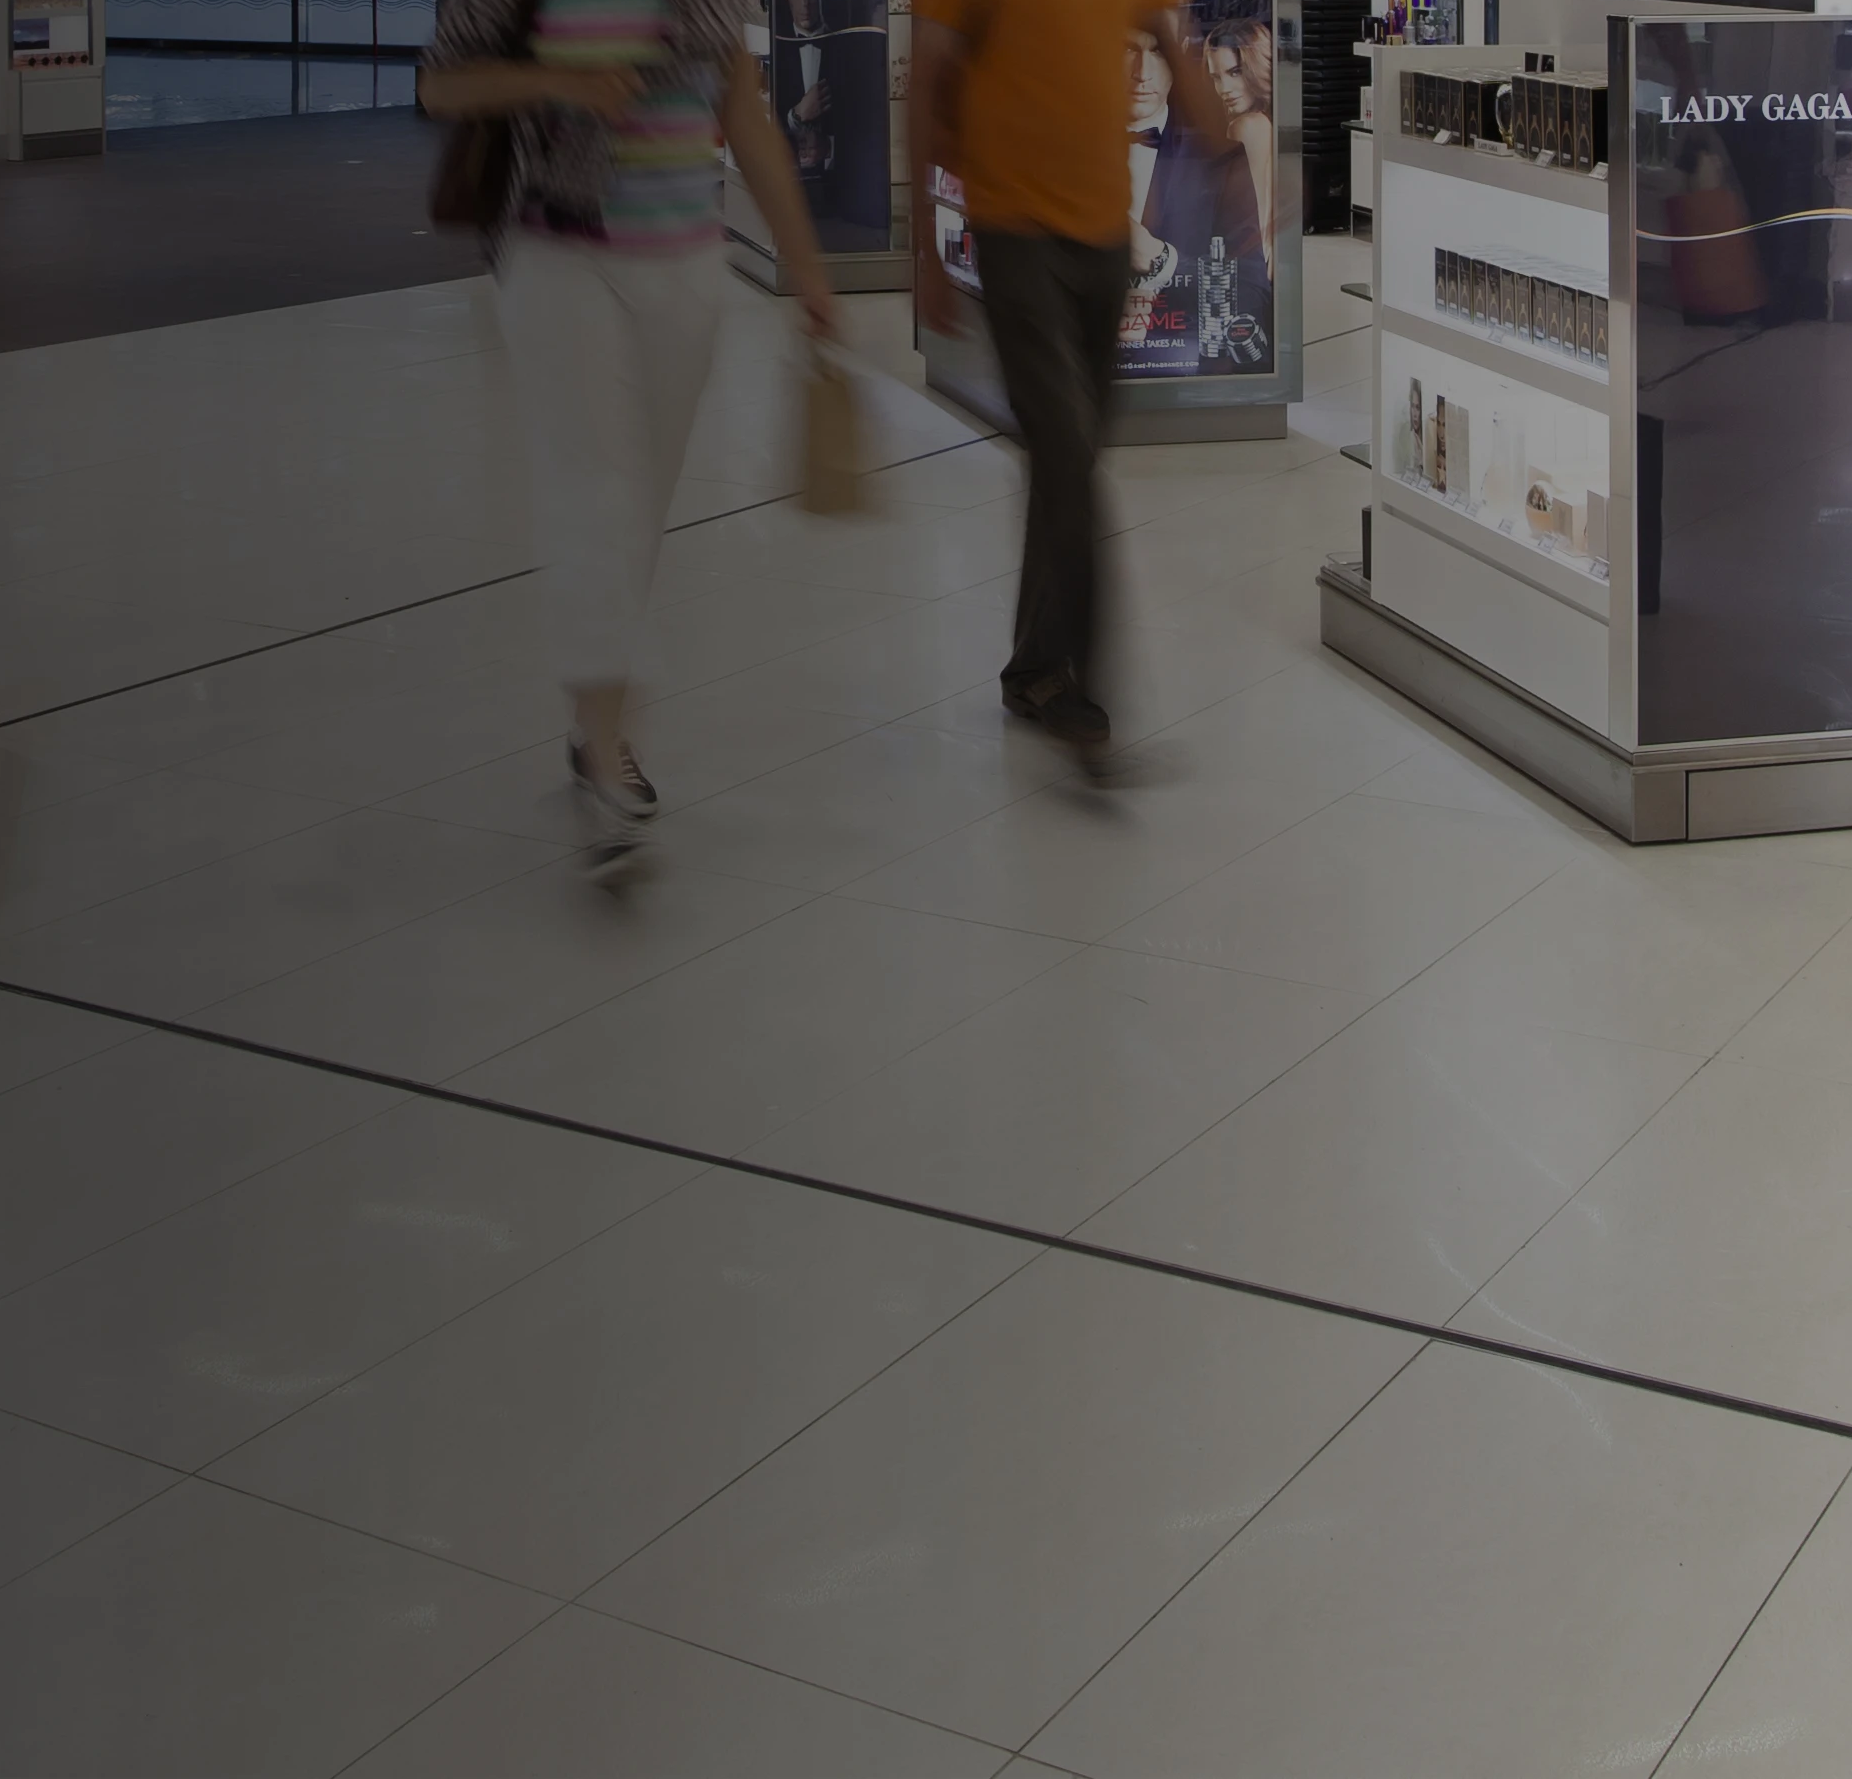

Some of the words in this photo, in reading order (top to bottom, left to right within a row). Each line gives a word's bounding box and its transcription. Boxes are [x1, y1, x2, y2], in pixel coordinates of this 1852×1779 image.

[1660, 94, 1754, 124] LADY
[1129, 294, 1168, 308] THE
[1146, 339, 1169, 348] TAKES
[1171, 338, 1186, 347] ALL
